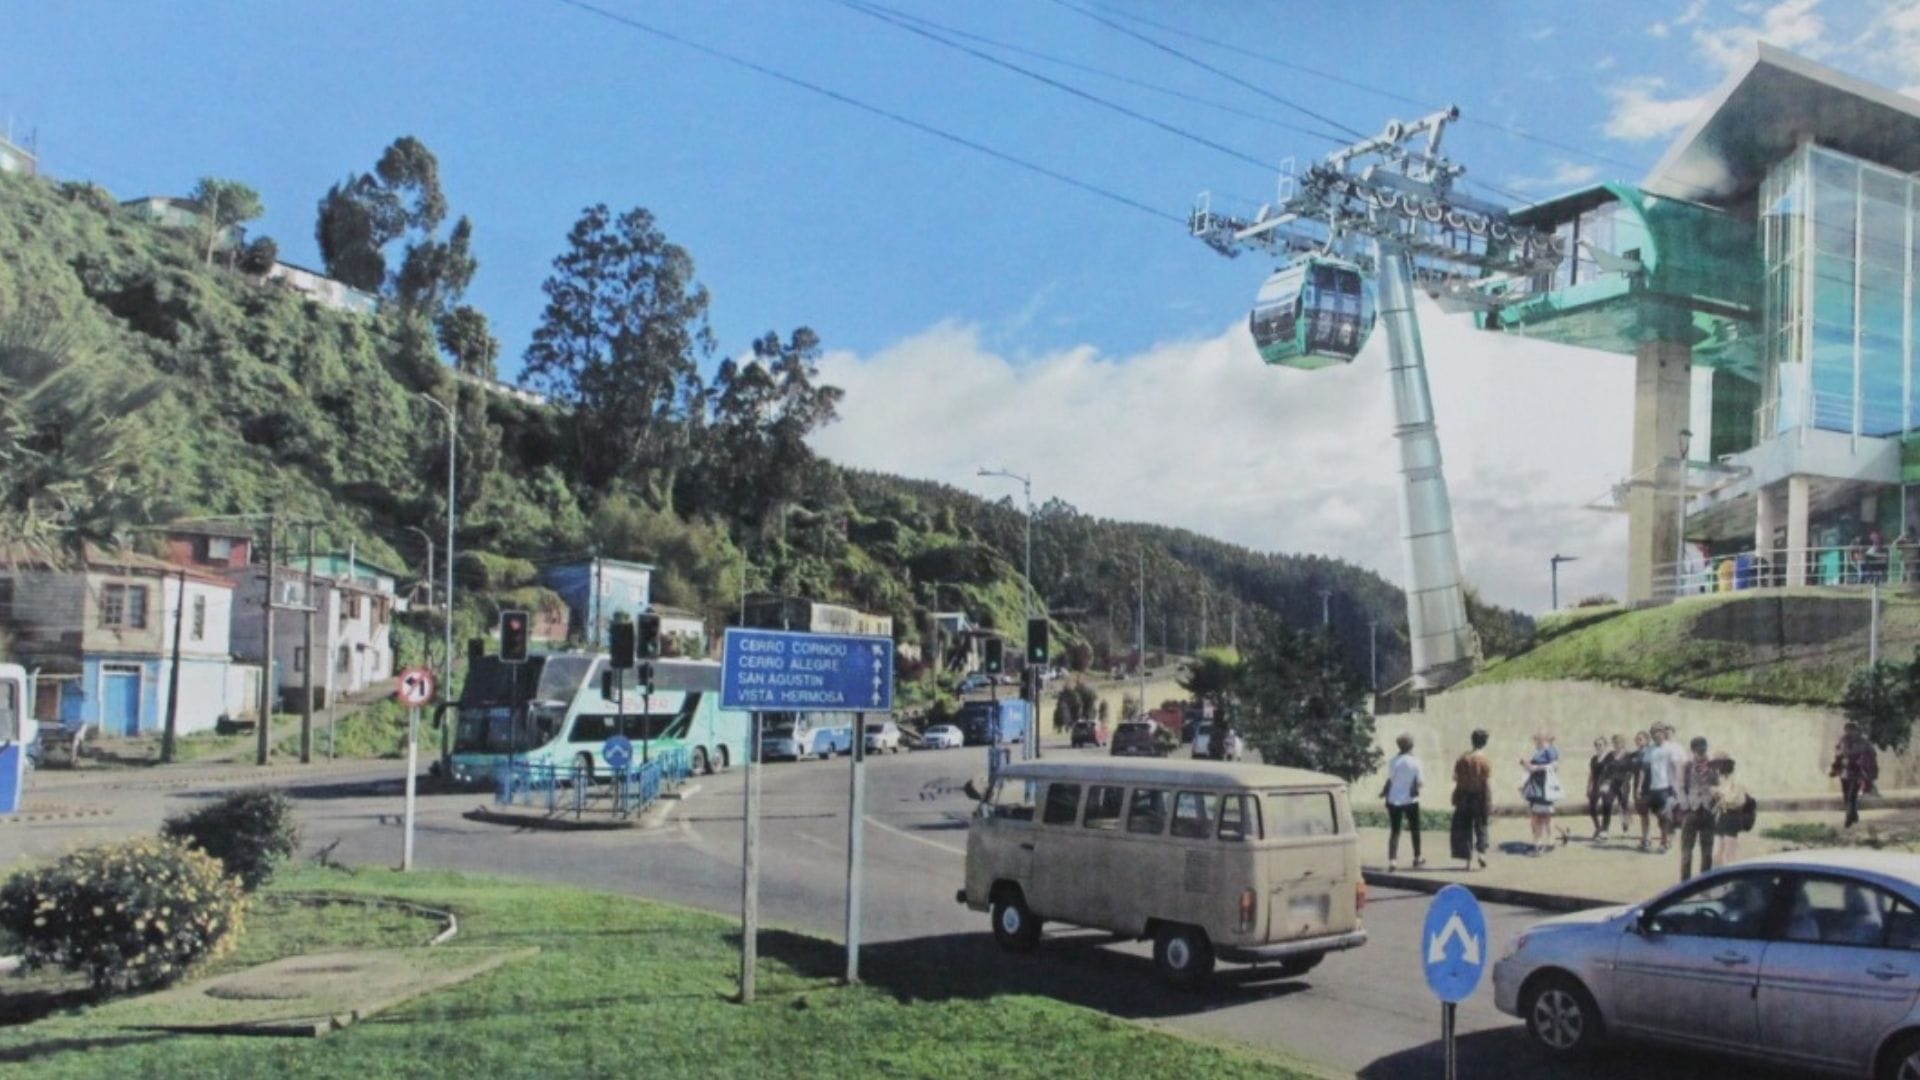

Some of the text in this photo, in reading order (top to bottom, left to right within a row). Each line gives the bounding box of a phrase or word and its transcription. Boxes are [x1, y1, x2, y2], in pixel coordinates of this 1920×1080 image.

[739, 656, 840, 671] CERRO ALEGRE
[738, 672, 764, 685] SAN
